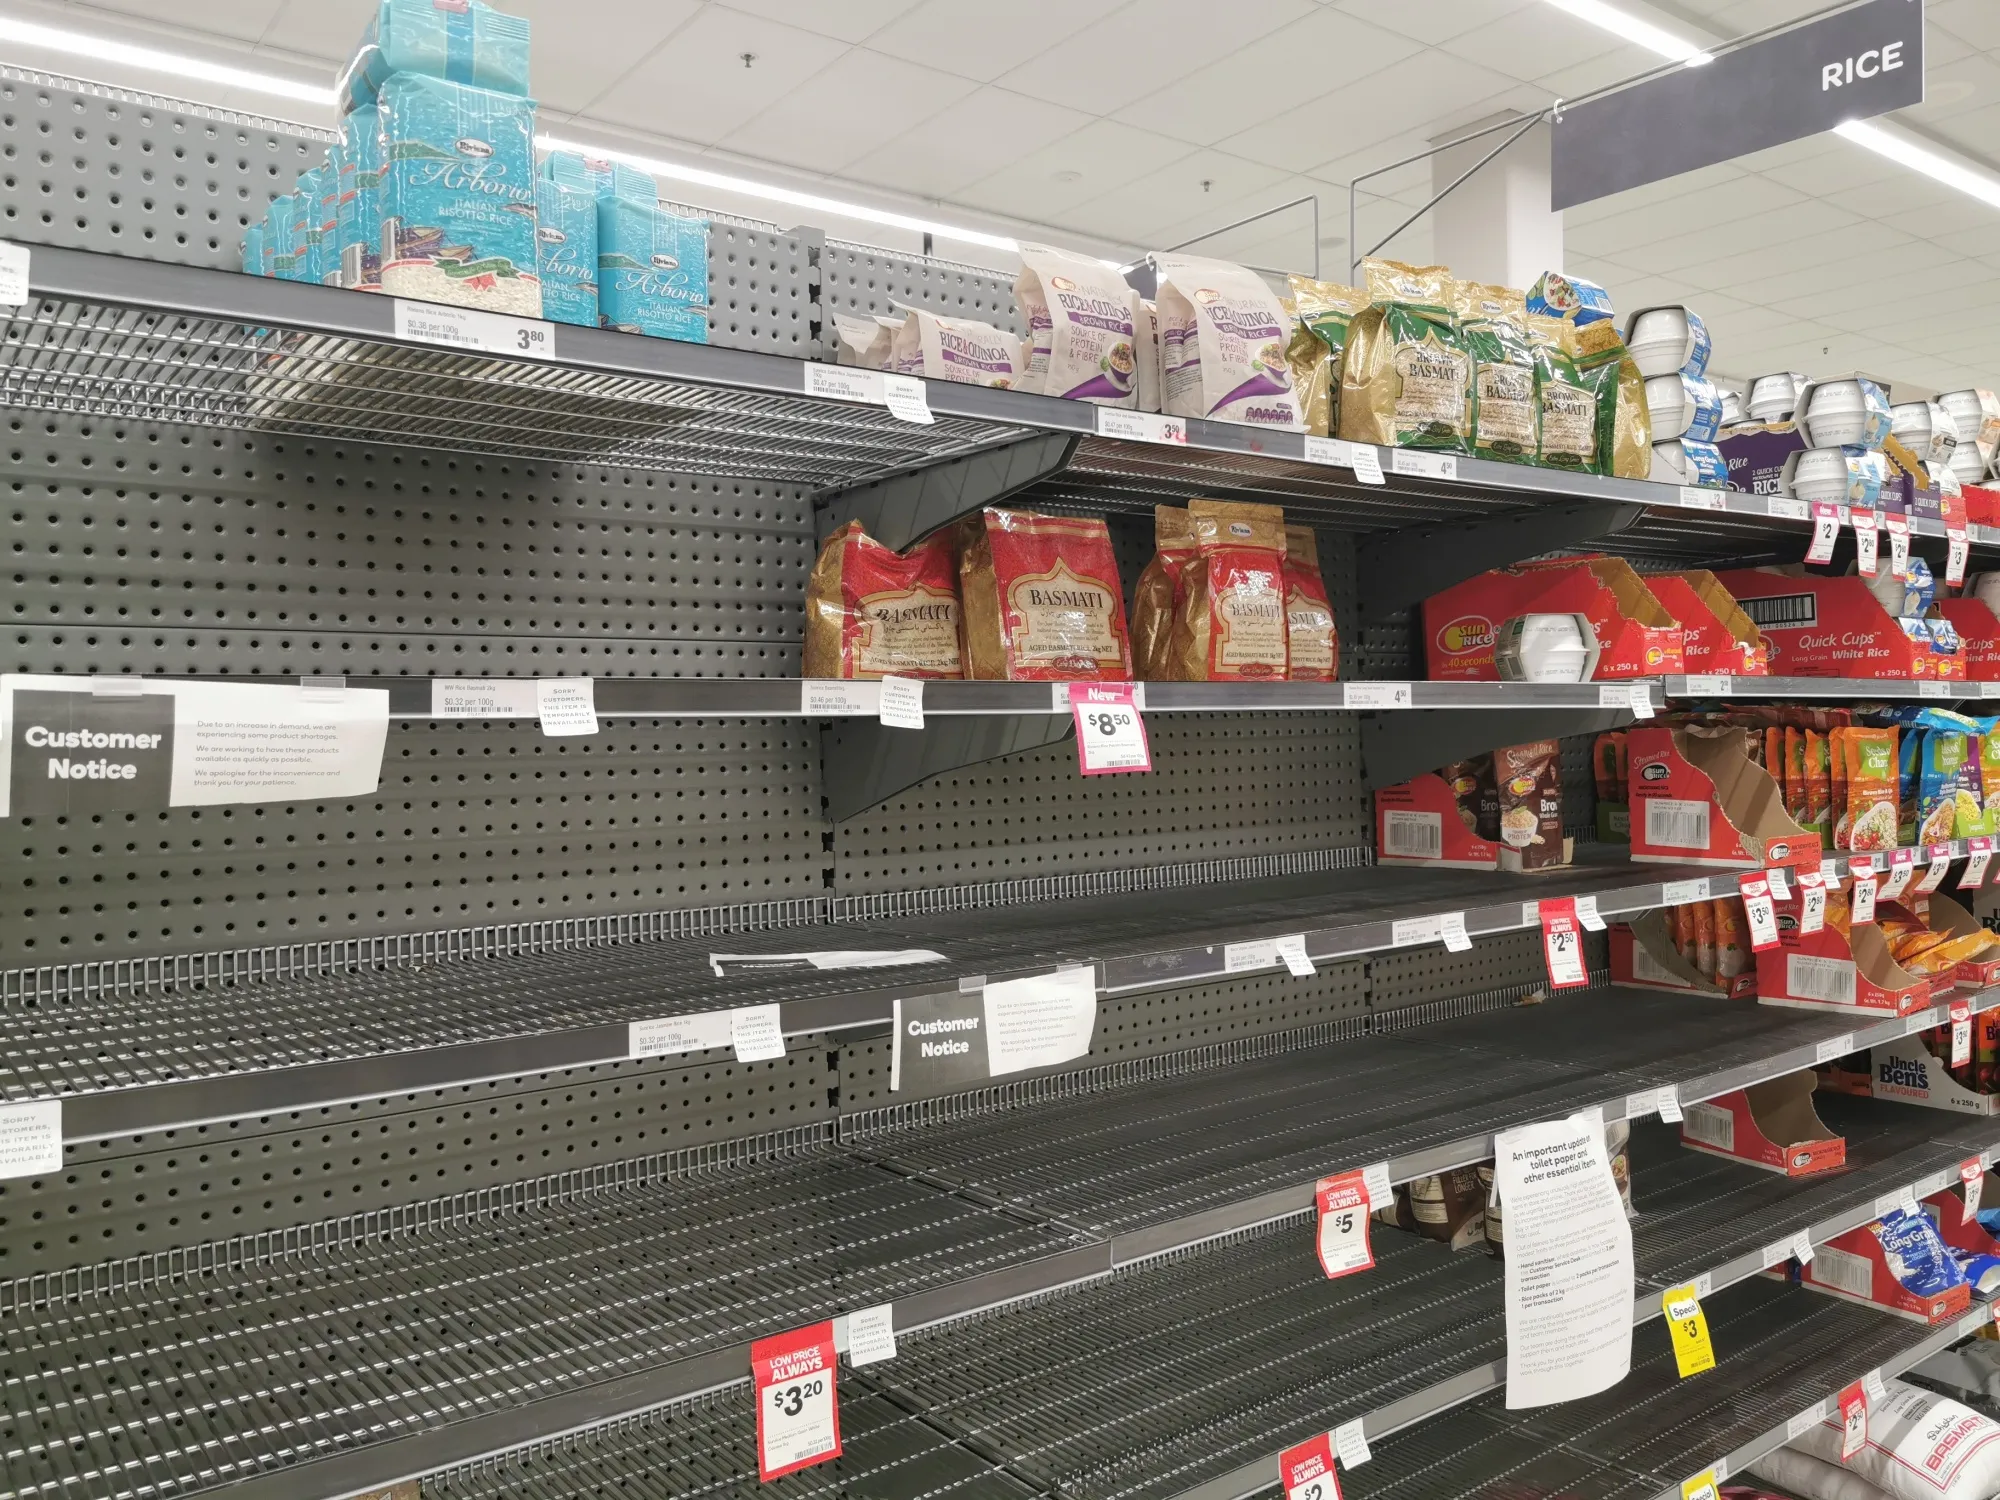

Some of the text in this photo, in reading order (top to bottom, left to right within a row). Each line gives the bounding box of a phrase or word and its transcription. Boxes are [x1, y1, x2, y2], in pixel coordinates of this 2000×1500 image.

[1822, 40, 1904, 92] RICE
[409, 162, 532, 200] Arborio
[454, 200, 497, 213] ITALIAN
[438, 207, 513, 226] RISOTTO RICE
[615, 272, 704, 304] Arborio
[651, 302, 684, 314] ITALIAN
[637, 308, 692, 324] RISOTTO RICE
[407, 319, 459, 335] $0.38 per 100g
[1080, 315, 1126, 333] BROWN RICE
[1071, 325, 1098, 340] SOURCE
[1249, 329, 1268, 338] RICE
[1071, 338, 1103, 353] PROTEIN
[953, 355, 1000, 372] BROWN RICE
[1069, 349, 1099, 364] & FIBRE
[1546, 391, 1580, 402] BROWN
[1541, 401, 1588, 416] BASMATI
[1728, 456, 1749, 472] Rice
[1823, 523, 1832, 539] $2
[1030, 589, 1103, 608] BASMATI
[1459, 622, 1486, 637] Sun
[1462, 631, 1496, 646] RICE
[1799, 632, 1836, 651] Quick
[1685, 645, 1710, 656] Rice
[1791, 648, 1890, 663] Long Grain White Rice
[1448, 656, 1494, 667] 40 seconds
[1603, 664, 1609, 672] 6
[1616, 663, 1631, 672] 250
[1088, 687, 1116, 701] New
[444, 698, 494, 708] $0.32 per 100g
[543, 711, 590, 719] TEMPORARILY
[197, 720, 213, 728] Due
[236, 721, 268, 730] increase
[278, 723, 312, 731] demand,
[25, 725, 162, 749] Customer
[196, 731, 247, 741] experiencing
[269, 732, 299, 741] product
[300, 732, 339, 741] shortages.
[196, 744, 209, 752] We
[224, 746, 255, 755] working
[285, 746, 306, 754] these
[307, 747, 340, 755] products
[195, 755, 231, 763] available
[243, 756, 270, 764] quickly
[280, 756, 312, 764] possible.
[48, 758, 138, 779] Notice
[209, 769, 246, 778] apologise
[273, 769, 325, 777] inconvenience
[326, 769, 341, 777] and
[262, 779, 297, 787] patience.
[1551, 923, 1573, 932] ALWAYS
[745, 1014, 766, 1022] SORRY
[908, 1016, 979, 1036] Customer
[639, 1033, 682, 1045] $0.32 per 100g
[921, 1039, 970, 1058] Notice
[1889, 1055, 1927, 1074] Uncle
[1880, 1084, 1929, 1099] FLAVOURED
[1961, 1100, 1974, 1108] 250
[1975, 1102, 1980, 1110] g
[3, 1115, 36, 1125] SORRY
[1512, 1152, 1524, 1162] An
[1523, 1142, 1568, 1160] important
[1567, 1136, 1587, 1151] update
[1530, 1148, 1588, 1170] toilet paper and
[1523, 1158, 1597, 1184] other essential items
[1326, 1187, 1358, 1200] LOW PRICE
[1454, 1181, 1475, 1194] LONGER
[1328, 1195, 1362, 1211] ALWAYS
[1335, 1213, 1354, 1234] $5
[1882, 1235, 1913, 1252] Long
[1520, 1272, 1551, 1283] transaction
[1521, 1281, 1551, 1293] Toilet paper
[1521, 1294, 1533, 1303] Rice
[1532, 1291, 1549, 1302] packs
[1673, 1303, 1696, 1317] Special
[860, 1315, 879, 1325] SORRY
[1683, 1320, 1698, 1338] $3
[852, 1336, 890, 1348] TEMPORARILY
[769, 1346, 822, 1370] LOW PRICE
[771, 1357, 824, 1383] ALWAYS
[1291, 1453, 1322, 1475] LOW PRICE
[1293, 1462, 1326, 1486] ALWAYS
